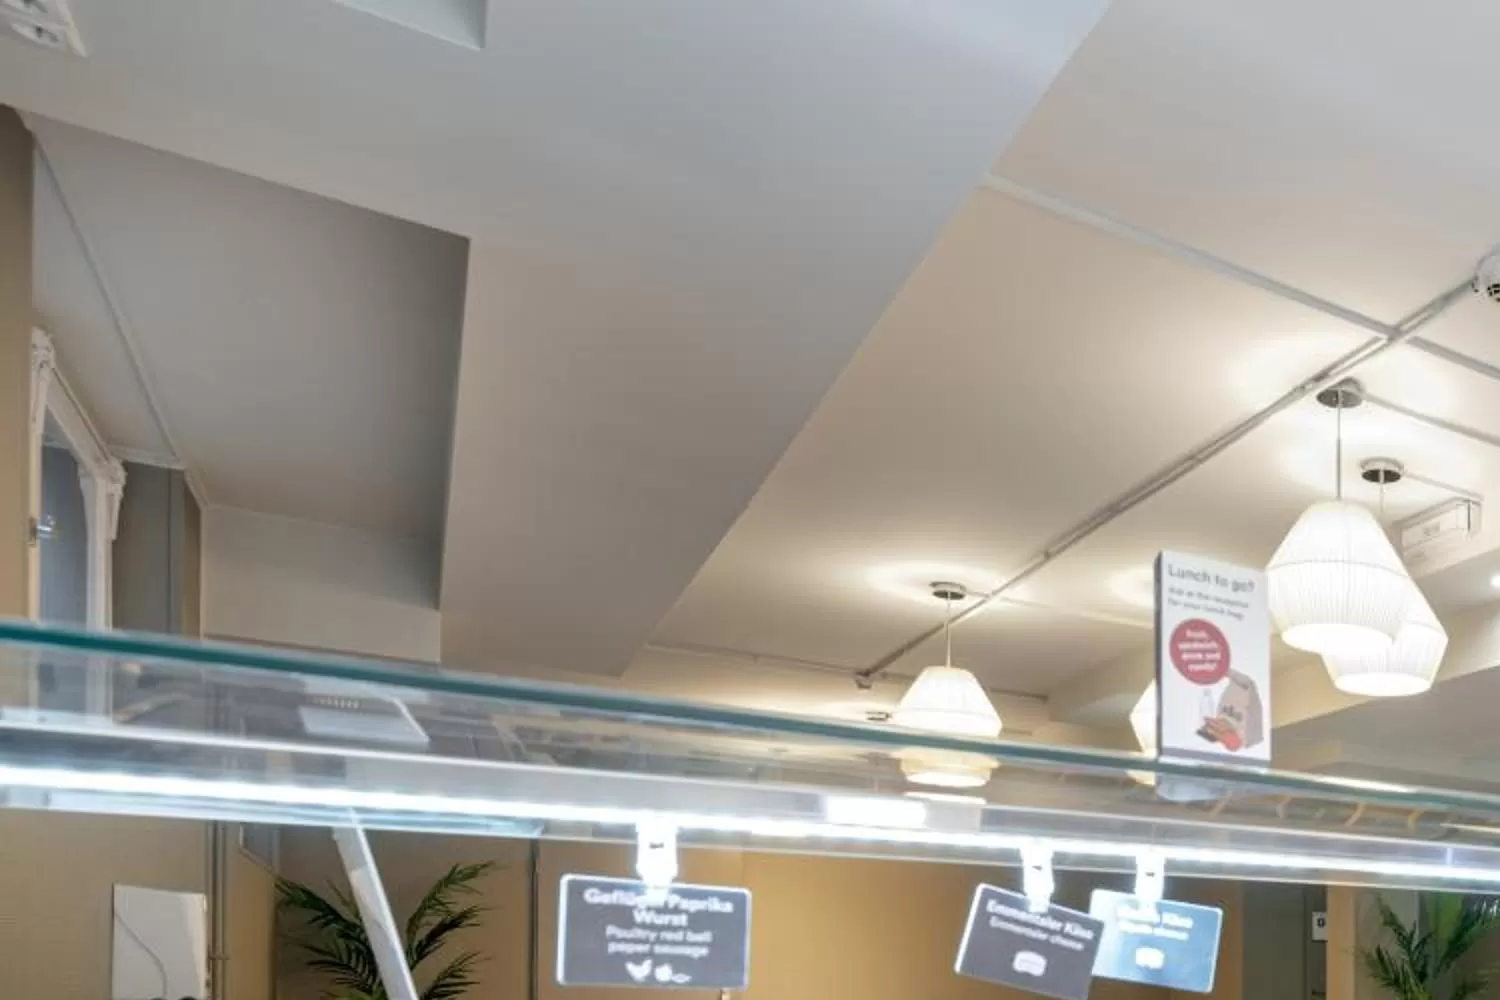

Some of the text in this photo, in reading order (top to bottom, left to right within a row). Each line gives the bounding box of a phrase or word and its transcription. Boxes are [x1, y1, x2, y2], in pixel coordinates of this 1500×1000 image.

[1168, 563, 1210, 583] Lunch
[1215, 575, 1228, 587] to
[667, 893, 735, 913] Paprika
[633, 908, 688, 926] Wurst
